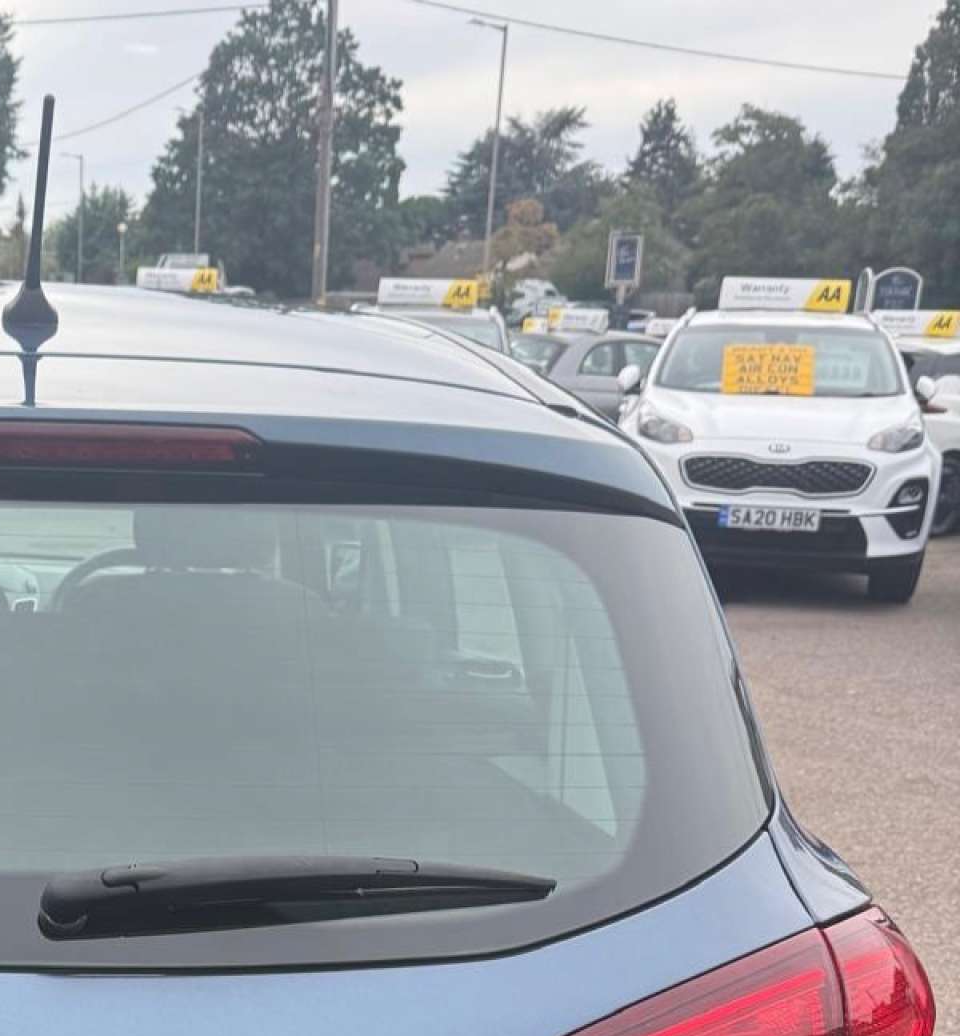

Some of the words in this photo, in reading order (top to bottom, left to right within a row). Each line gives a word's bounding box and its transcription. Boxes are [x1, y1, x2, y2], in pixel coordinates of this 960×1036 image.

[817, 285, 842, 303] AA
[731, 509, 777, 526] SA20
[781, 511, 816, 528] HBK
